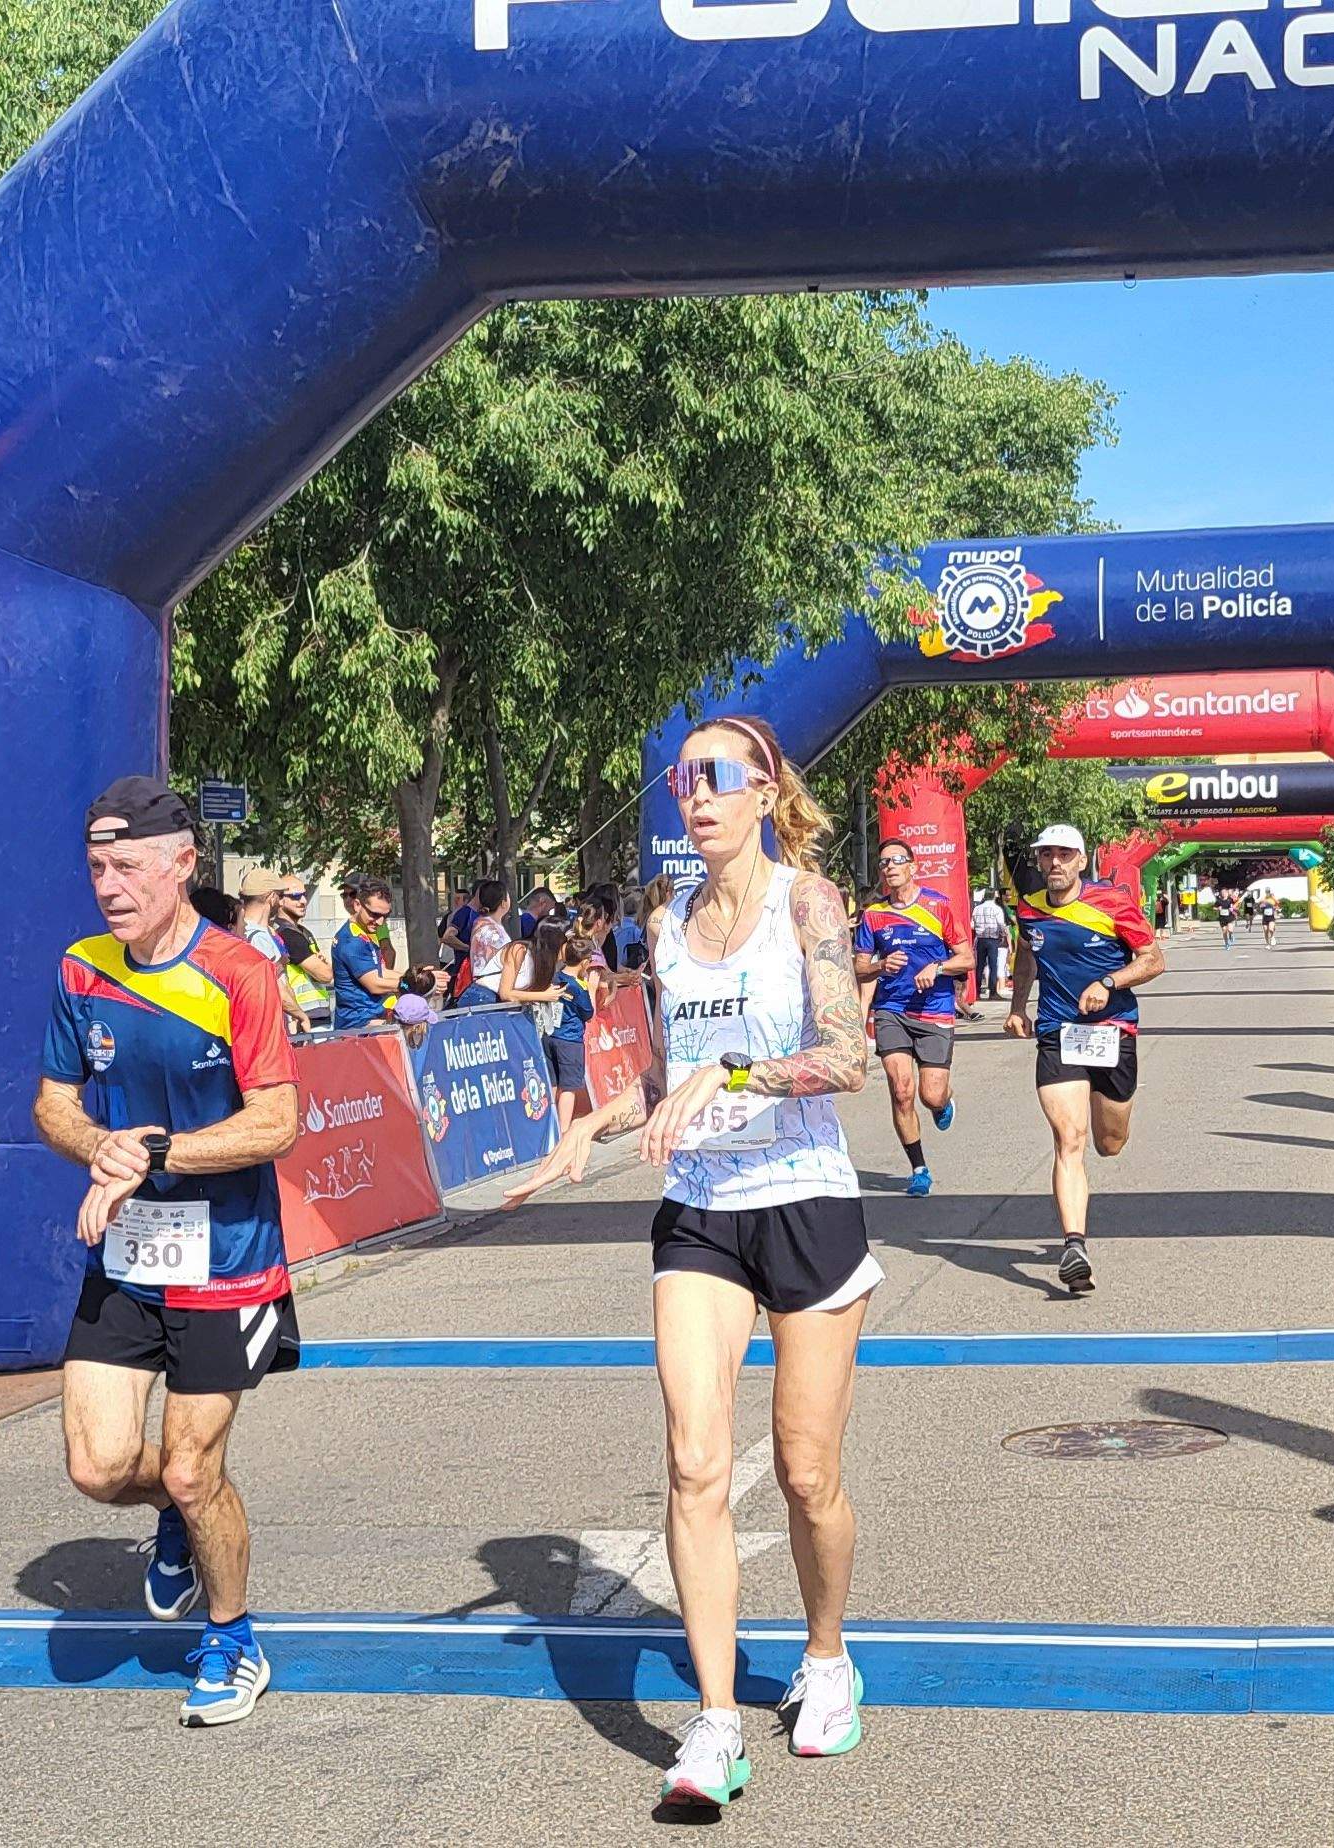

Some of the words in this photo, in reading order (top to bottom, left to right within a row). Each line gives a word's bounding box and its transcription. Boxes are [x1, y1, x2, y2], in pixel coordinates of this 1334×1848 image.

[948, 546, 1022, 566] mupol
[1137, 563, 1274, 592] Mutualidad
[1136, 597, 1167, 622] de
[1174, 596, 1194, 621] la
[1202, 591, 1293, 620] Policía
[1153, 688, 1301, 718] Santander
[1110, 727, 1203, 739] sportssantander.es
[1146, 769, 1278, 803] embou
[899, 823, 938, 838] Sports
[911, 843, 956, 854] ntander
[663, 860, 708, 877] mup
[673, 997, 748, 1021] ATLEET
[443, 1030, 508, 1071] Mutualidad
[1074, 1044, 1106, 1058] 152
[324, 1091, 383, 1128] Santander
[124, 1239, 183, 1268] 330
